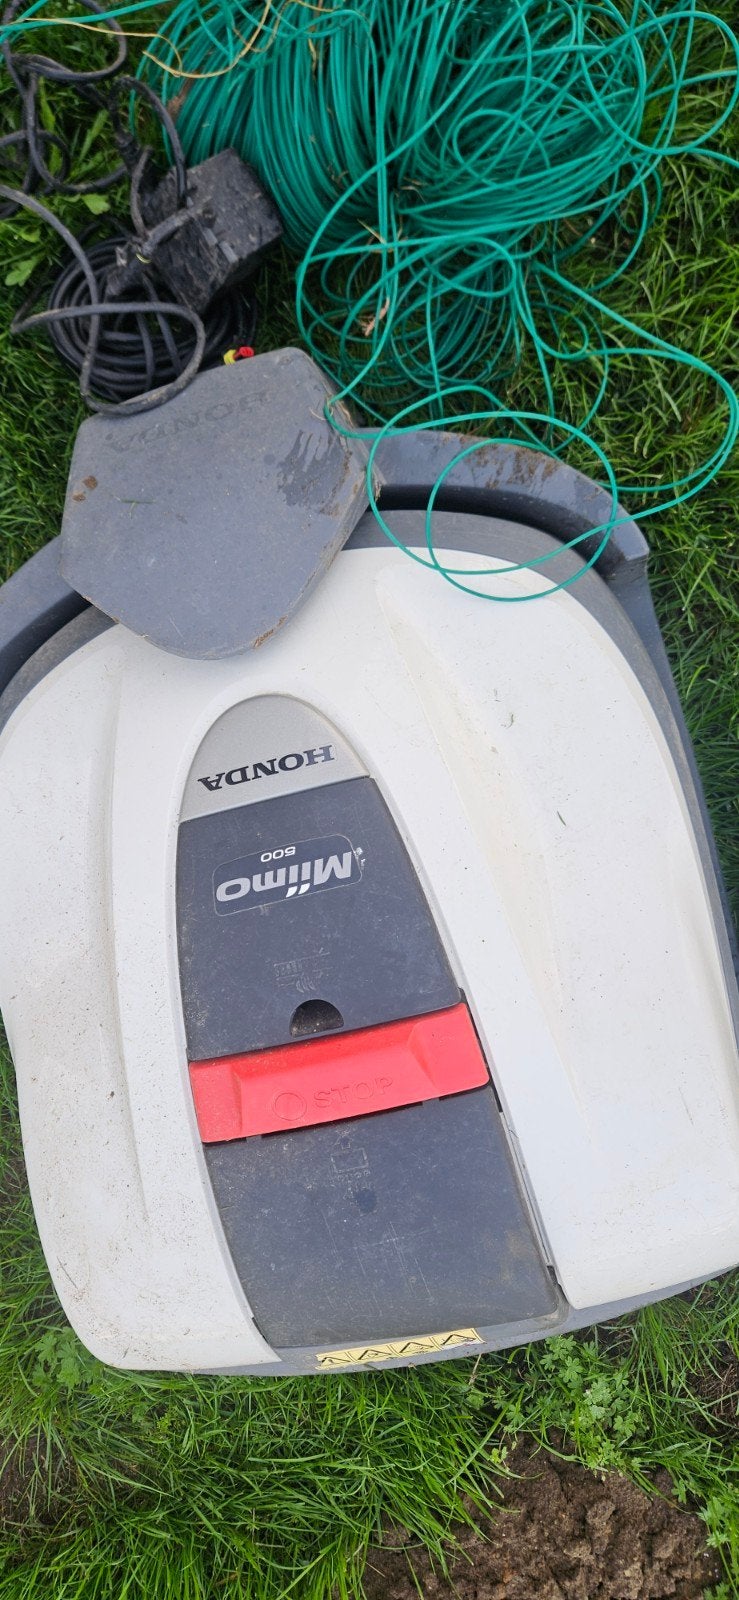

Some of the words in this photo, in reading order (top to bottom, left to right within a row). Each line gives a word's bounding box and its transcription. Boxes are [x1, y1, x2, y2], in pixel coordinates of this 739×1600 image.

[197, 745, 335, 791] HONDA
[260, 846, 296, 863] 500
[215, 851, 352, 902] Miimo
[312, 1077, 394, 1109] STOP
